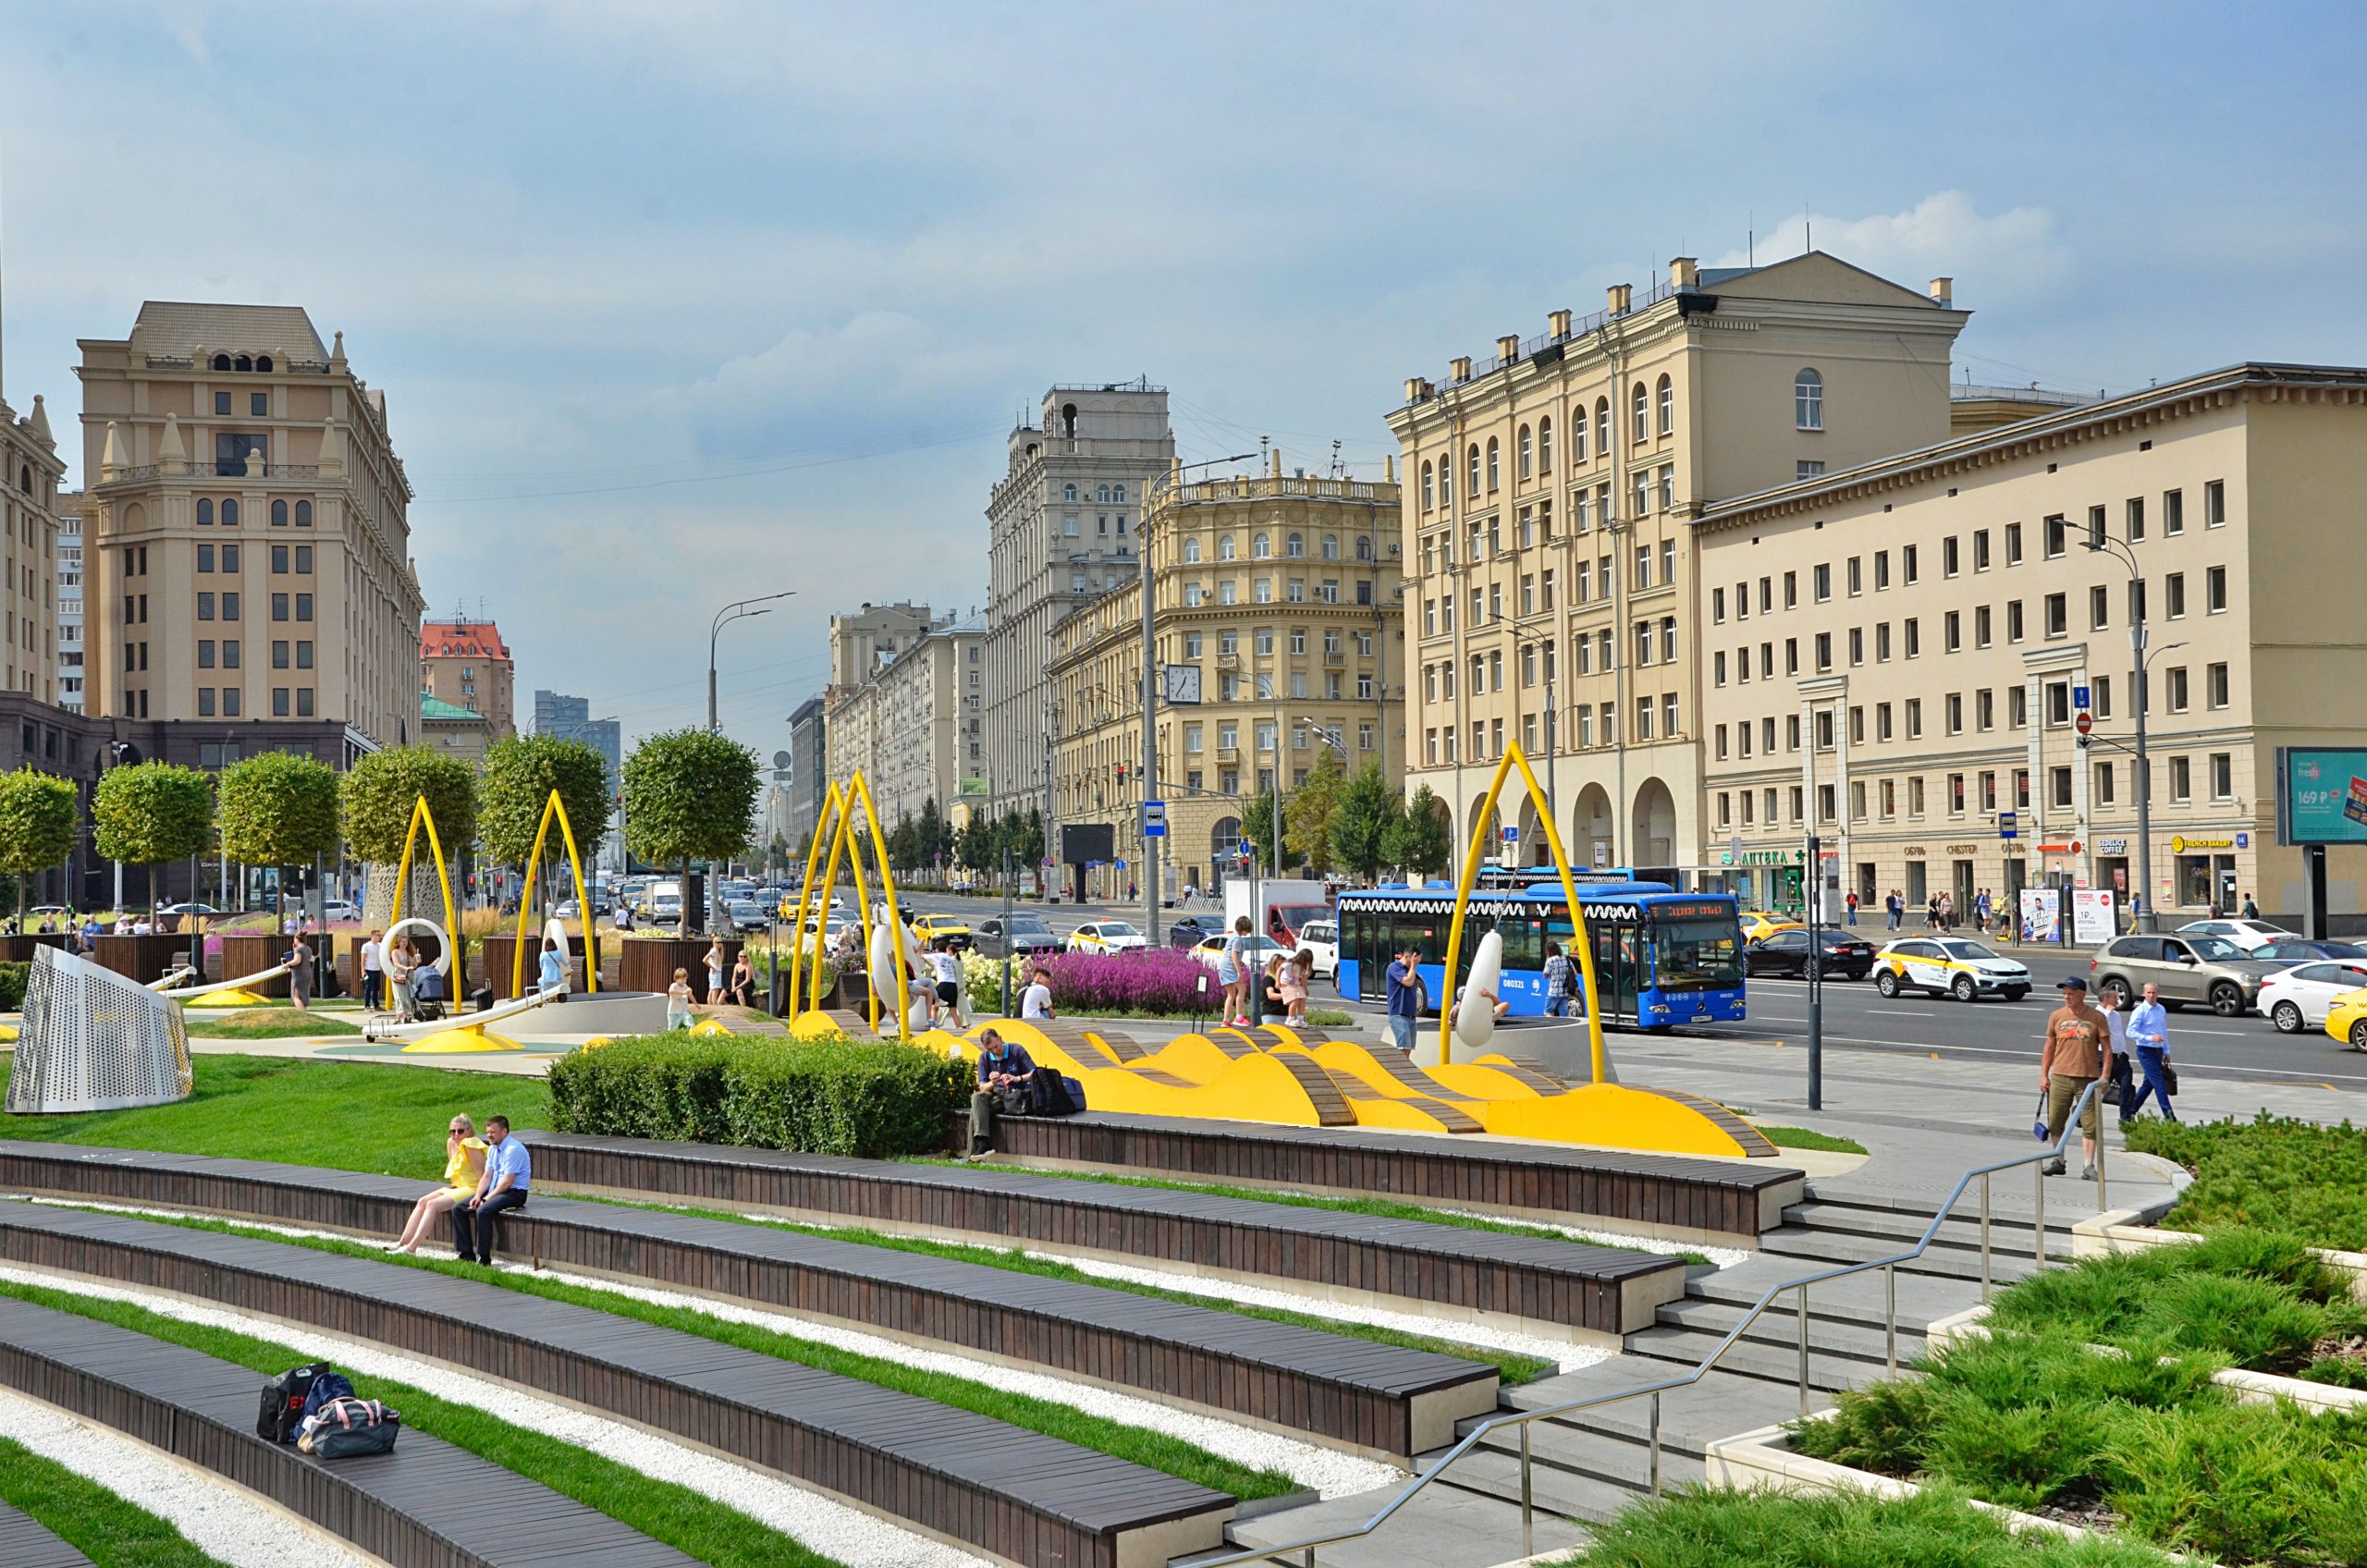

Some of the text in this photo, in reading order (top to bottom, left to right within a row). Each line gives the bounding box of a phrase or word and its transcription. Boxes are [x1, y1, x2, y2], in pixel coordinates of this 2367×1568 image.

[2299, 791, 2317, 804] 169
[1946, 844, 1979, 855] CHESTER
[2100, 846, 2124, 854] COFFEE
[1741, 851, 1787, 865] АПТЕКА
[1502, 979, 1525, 989] 080321
